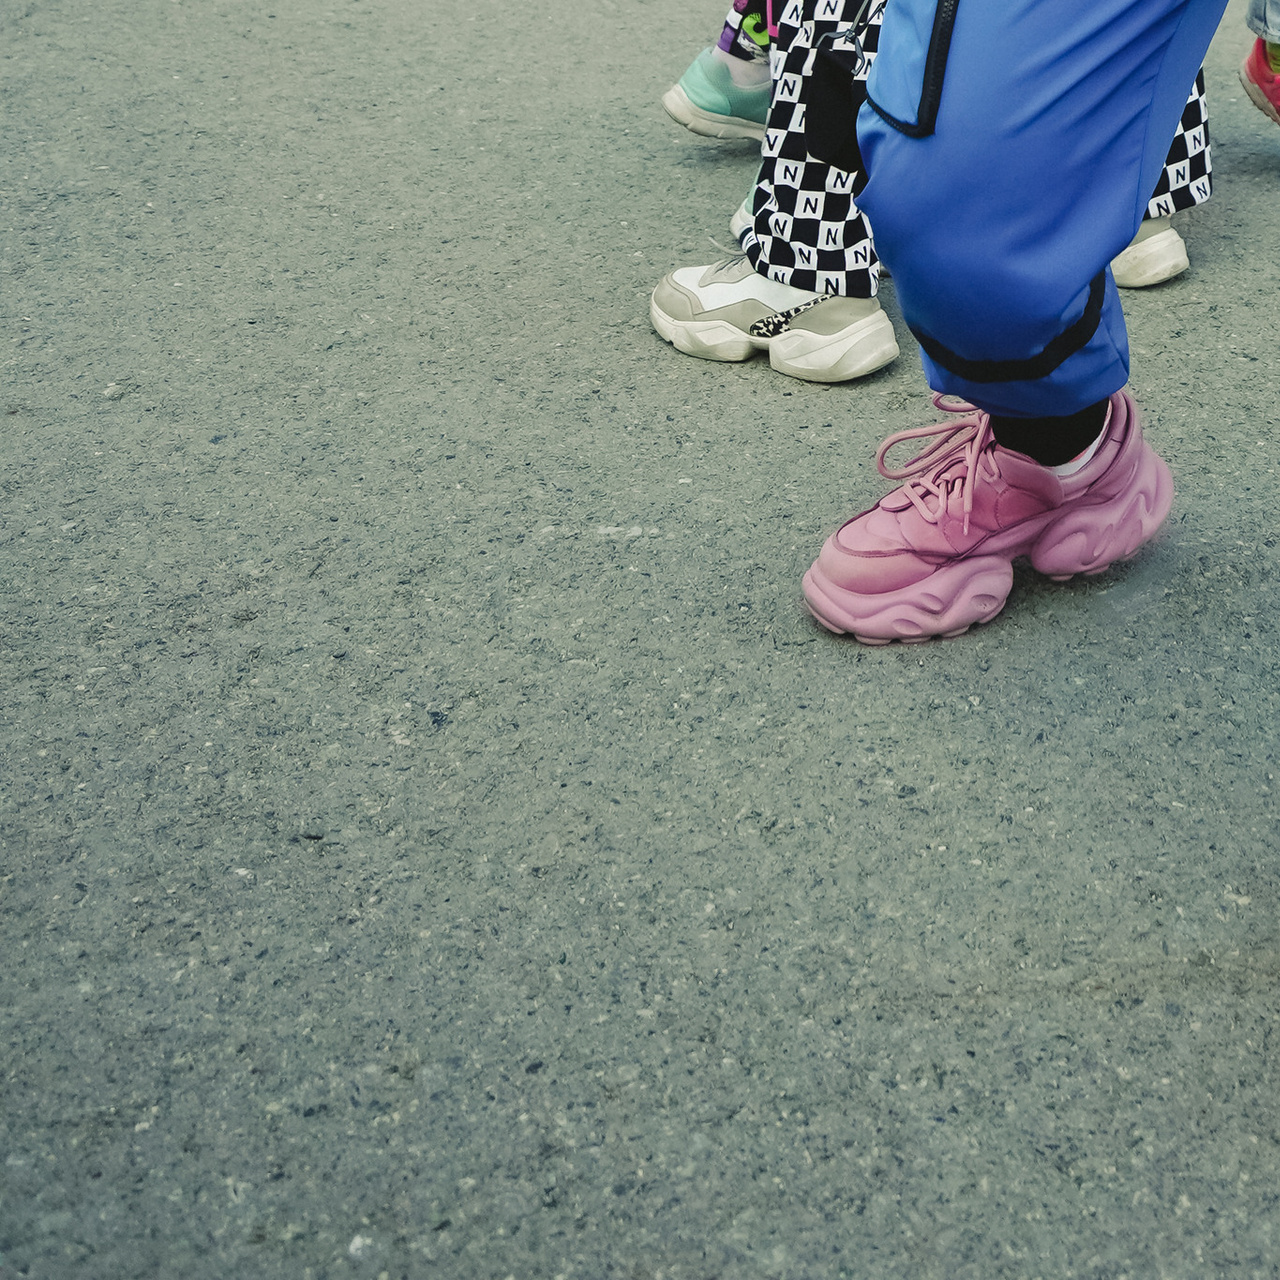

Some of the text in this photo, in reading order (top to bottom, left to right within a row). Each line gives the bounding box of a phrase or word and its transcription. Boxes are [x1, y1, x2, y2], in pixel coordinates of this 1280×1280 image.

[823, 0, 838, 15] N
[780, 79, 796, 96] N
[1193, 132, 1201, 150] N
[784, 165, 798, 182] N
[834, 172, 849, 189] N
[1176, 166, 1185, 184] N
[1196, 182, 1208, 199] N
[803, 198, 818, 214] N
[1156, 200, 1169, 216] N
[774, 218, 787, 236] N
[826, 228, 838, 245] N
[798, 248, 811, 264] N
[854, 246, 867, 264] N
[825, 277, 839, 295] N
